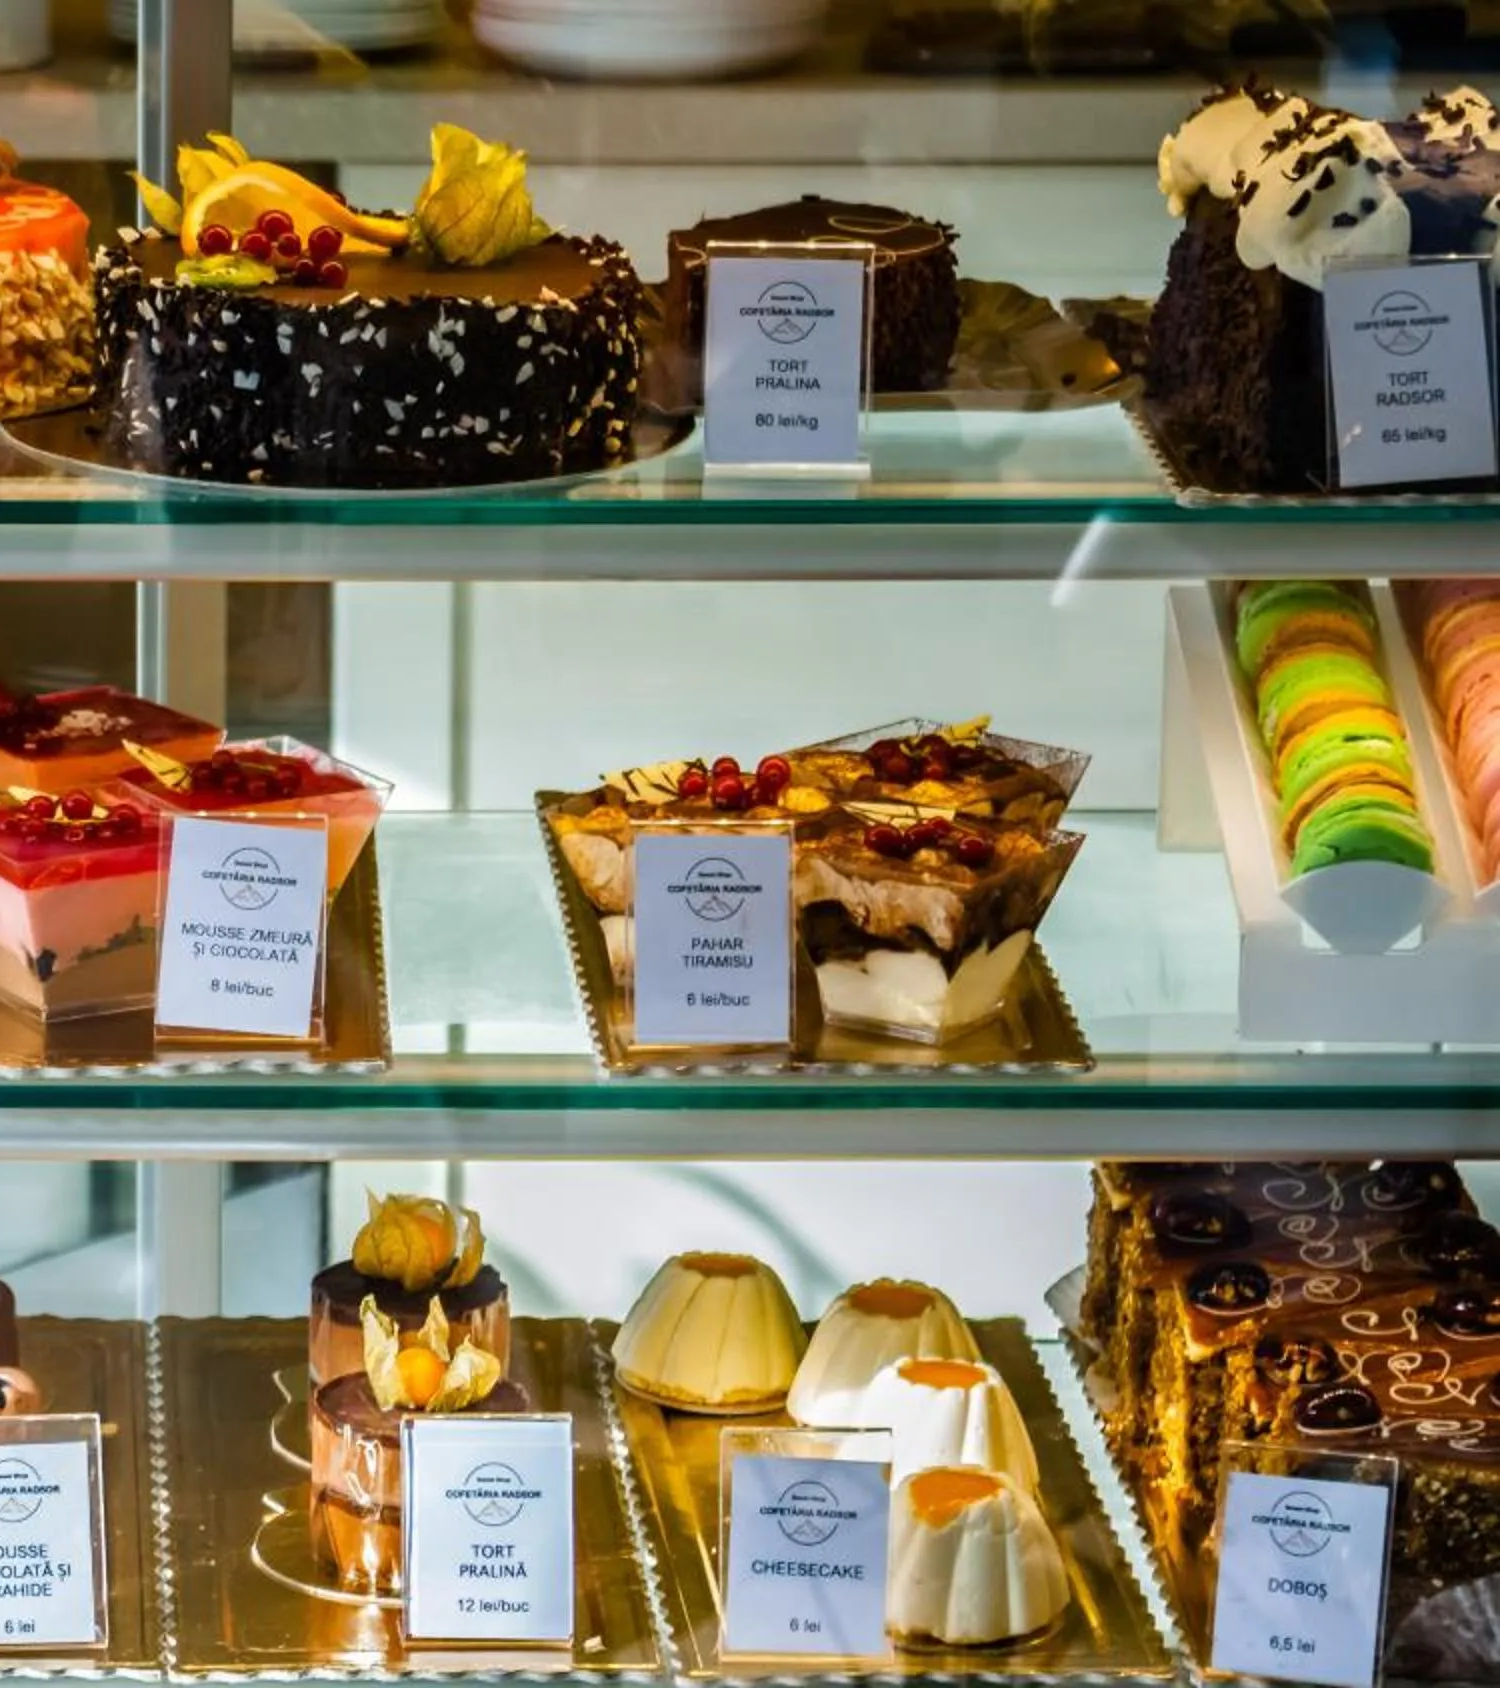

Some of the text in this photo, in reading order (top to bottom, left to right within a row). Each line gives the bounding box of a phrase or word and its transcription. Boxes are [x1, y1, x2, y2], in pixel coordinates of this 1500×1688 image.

[768, 359, 809, 373] TORT
[755, 377, 821, 390] PRALINA
[1388, 370, 1429, 387] TORT
[1376, 388, 1445, 407] RADSOR
[778, 414, 819, 430] lei/kg
[1406, 426, 1447, 443] lei/kg
[181, 922, 313, 947] MOUSSE ZMEURĂ
[691, 937, 744, 950] PAHAR
[210, 943, 299, 964] CIOCOLATĂ
[682, 955, 753, 969] TIRAMISU
[224, 980, 274, 997] lei/buc
[701, 992, 751, 1007] lei/buc
[471, 1544, 515, 1559] TORT
[459, 1561, 528, 1579] PRALINĂ
[751, 1560, 864, 1580] CHEESECAKE
[1268, 1577, 1328, 1603] DOBOȘ
[458, 1599, 530, 1613] 12 lei/buc
[4, 1620, 35, 1634] 6 lei
[789, 1618, 821, 1633] 6 lei
[1269, 1635, 1316, 1653] 6,5 lei
